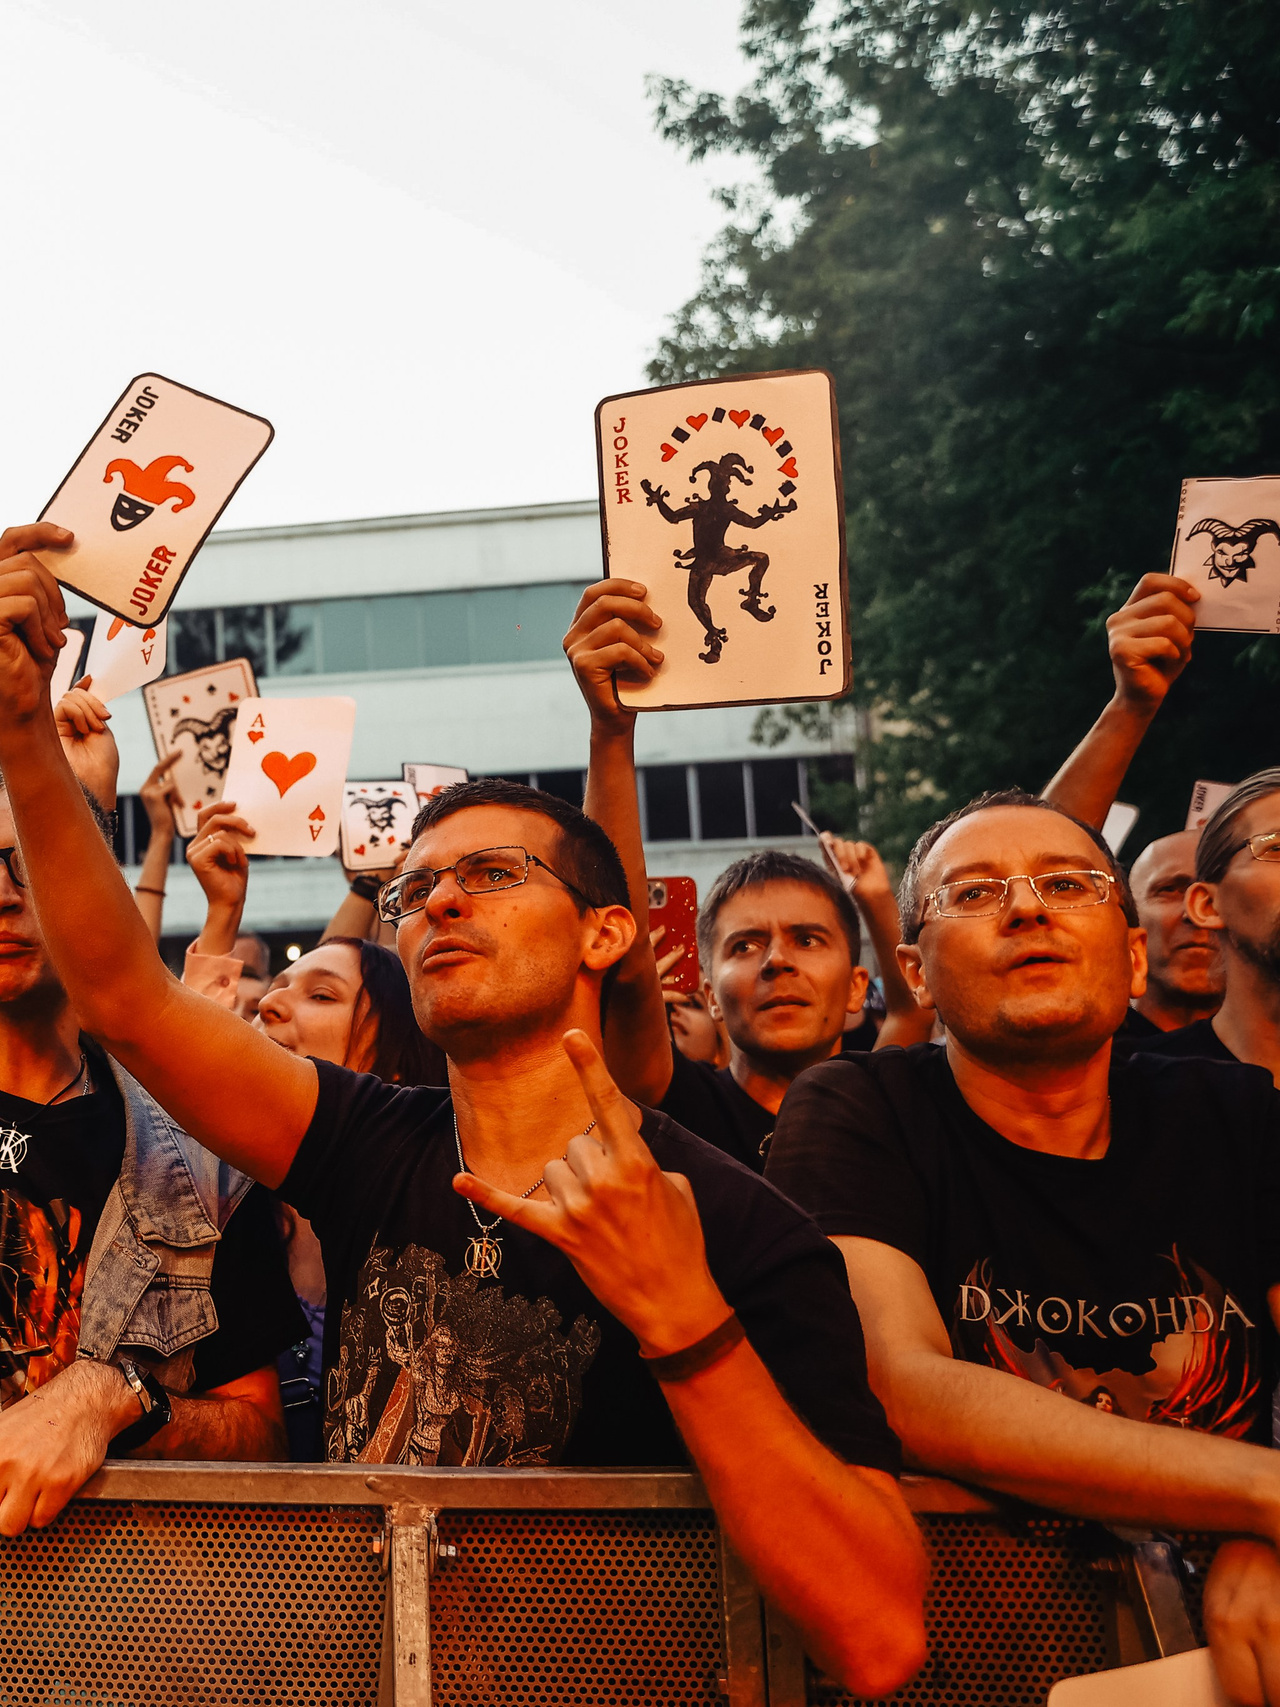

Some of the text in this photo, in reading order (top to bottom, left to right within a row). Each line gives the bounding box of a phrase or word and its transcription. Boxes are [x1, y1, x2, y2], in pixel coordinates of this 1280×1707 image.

[111, 385, 160, 444] JOKER
[613, 417, 633, 504] JOKER
[1178, 481, 1188, 520] JOKER
[129, 545, 177, 617] JOKER
[814, 583, 834, 675] JOKER
[141, 644, 154, 665] A
[251, 713, 266, 727] A
[309, 825, 323, 841] A
